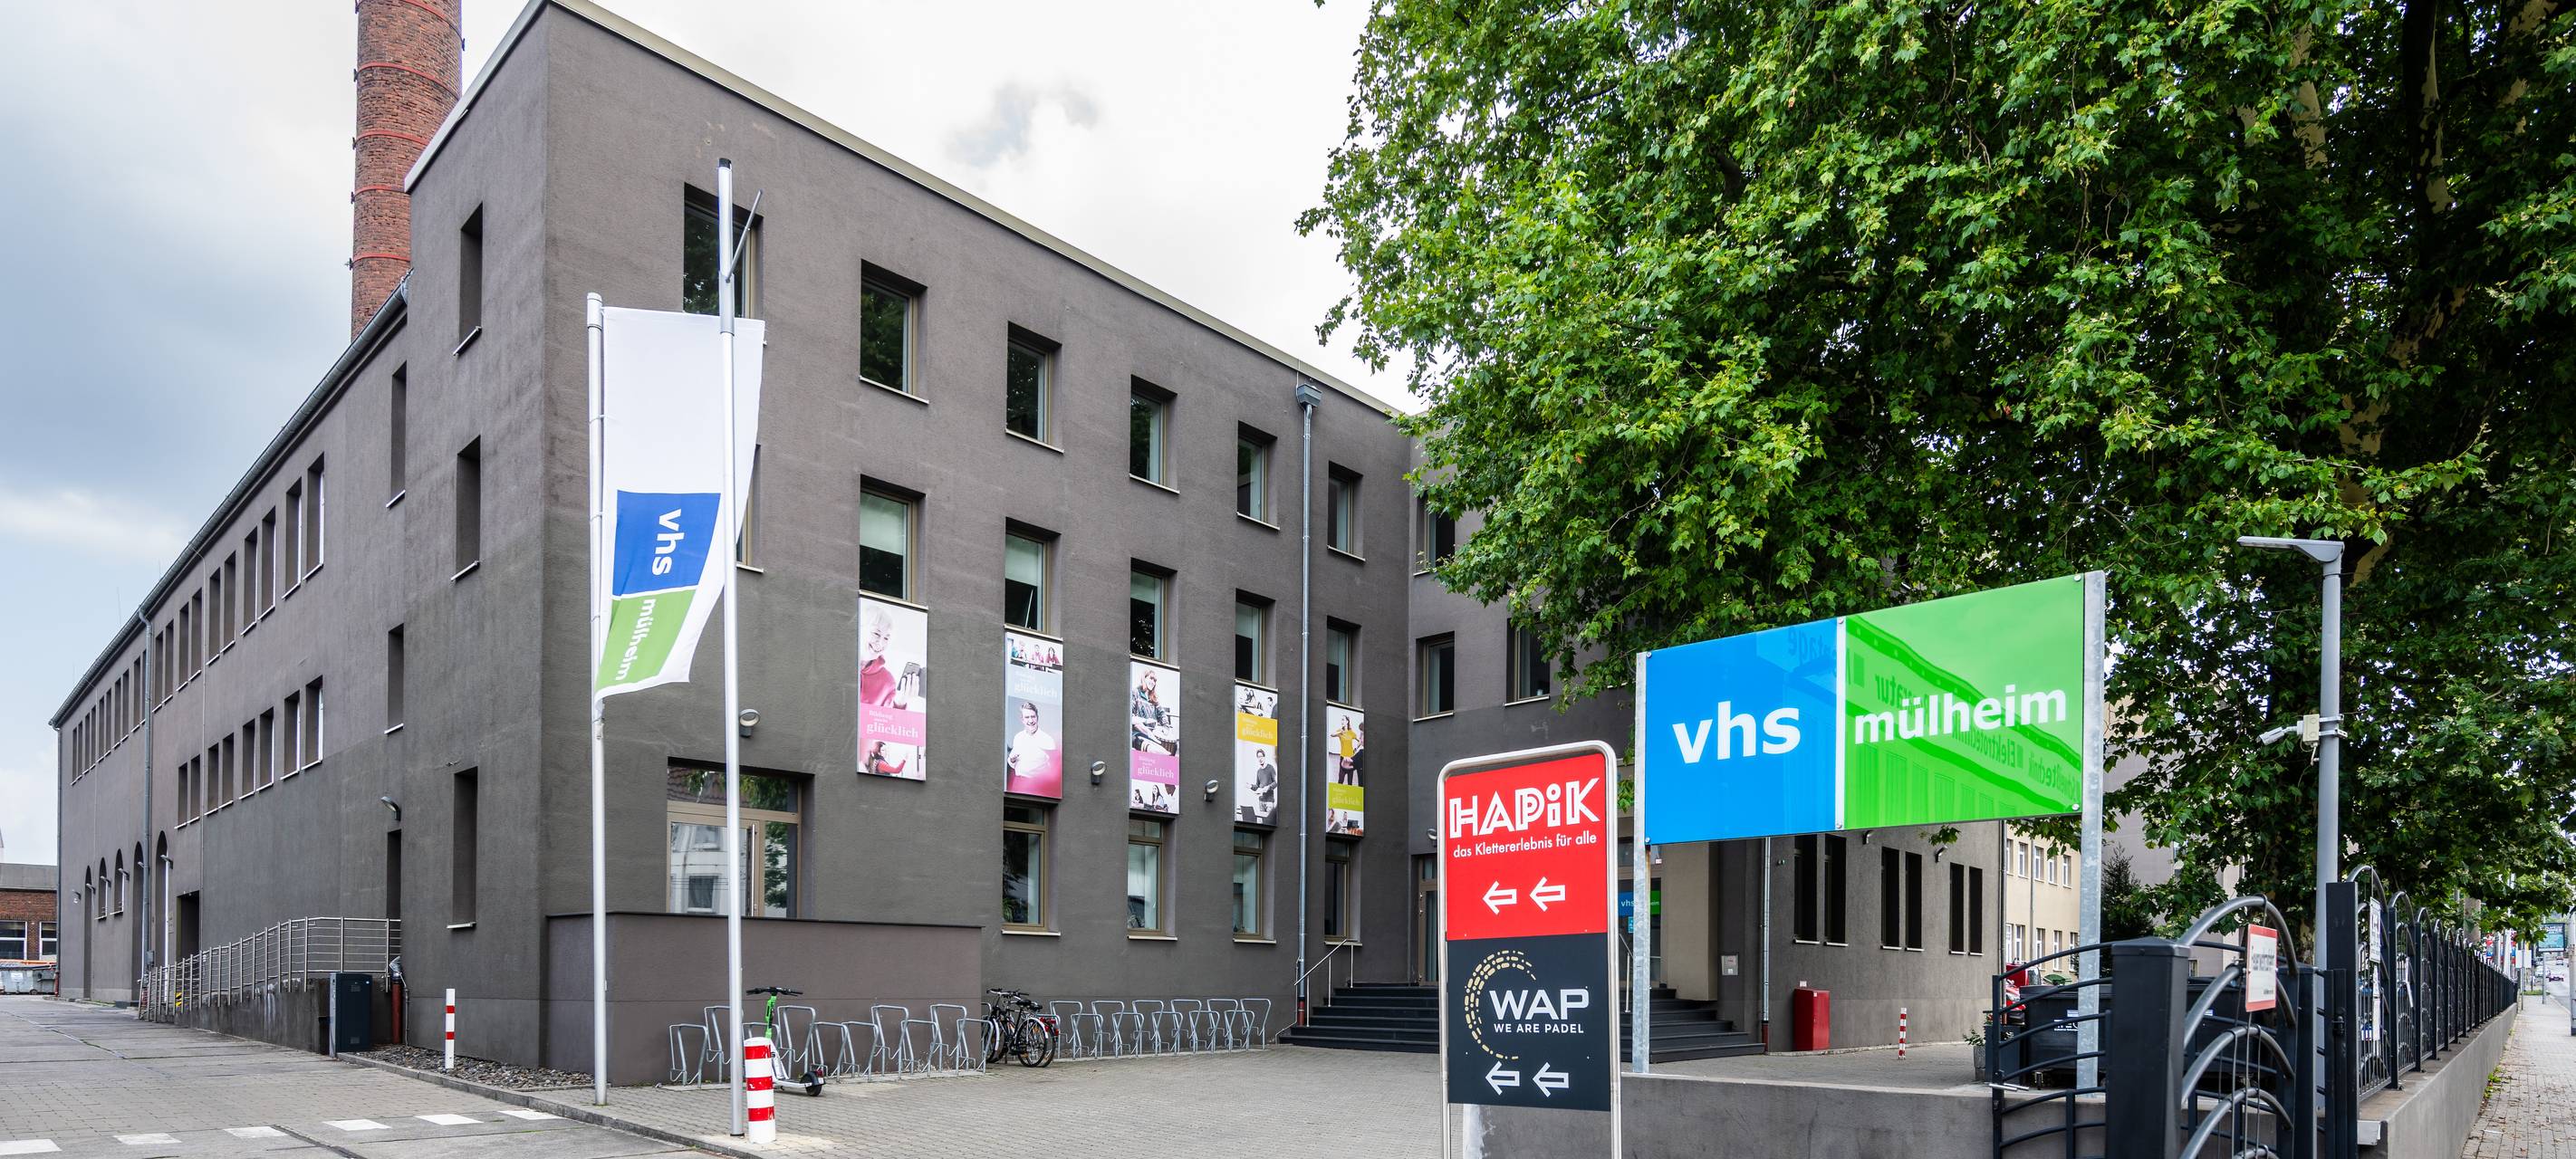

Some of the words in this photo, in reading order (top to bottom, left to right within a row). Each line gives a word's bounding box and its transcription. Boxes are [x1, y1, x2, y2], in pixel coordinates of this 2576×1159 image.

[652, 509, 684, 576] vhs
[615, 599, 656, 681] mülheim
[866, 722, 918, 738] glücklich
[1671, 701, 1801, 764] vhs
[1854, 684, 2066, 744] mülheim
[1138, 766, 1174, 779] glücklich
[1453, 845, 1472, 858] das
[1475, 836, 1552, 856] Klettererlebnis
[1556, 833, 1572, 848] für
[1575, 830, 1597, 845] alle
[1489, 989, 1590, 1020] WAP
[1494, 1023, 1512, 1033] WE
[1516, 1023, 1540, 1033] ARE
[1545, 1023, 1584, 1034] PADEL
